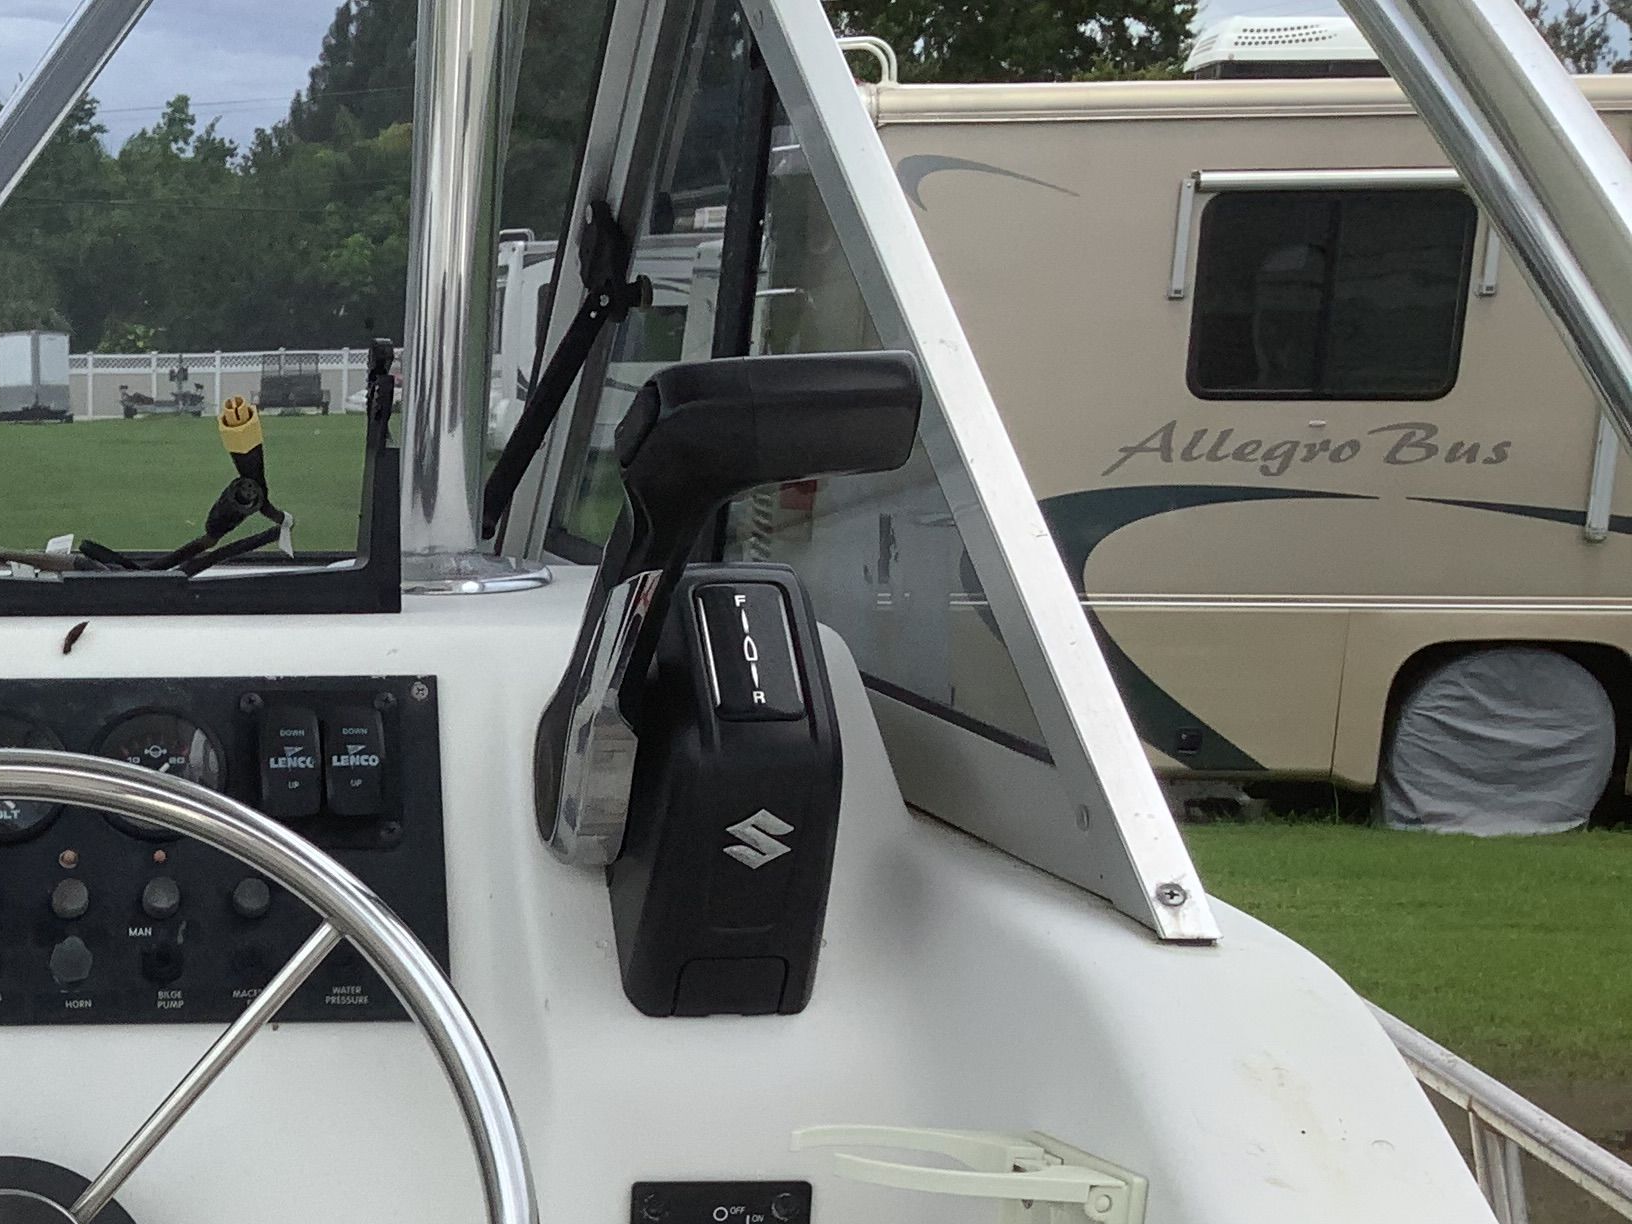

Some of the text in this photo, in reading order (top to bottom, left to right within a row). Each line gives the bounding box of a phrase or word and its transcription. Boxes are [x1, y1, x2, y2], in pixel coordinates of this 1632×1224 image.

[1101, 419, 1512, 476] Allegro Bus
[735, 595, 746, 607] F
[753, 691, 766, 705] R
[280, 729, 305, 737] DOWN
[342, 727, 368, 735] DOWN
[331, 754, 379, 766] LENCO
[288, 781, 300, 789] UP
[350, 779, 362, 787] UP
[128, 927, 152, 936] MAN
[157, 990, 182, 999] BILGE
[332, 986, 362, 994] WATER
[325, 995, 369, 1004] PRESSURE
[65, 1000, 92, 1009] HORN
[157, 1000, 184, 1009] PUMP
[730, 1206, 745, 1215] OFF
[751, 1214, 764, 1223] ON
